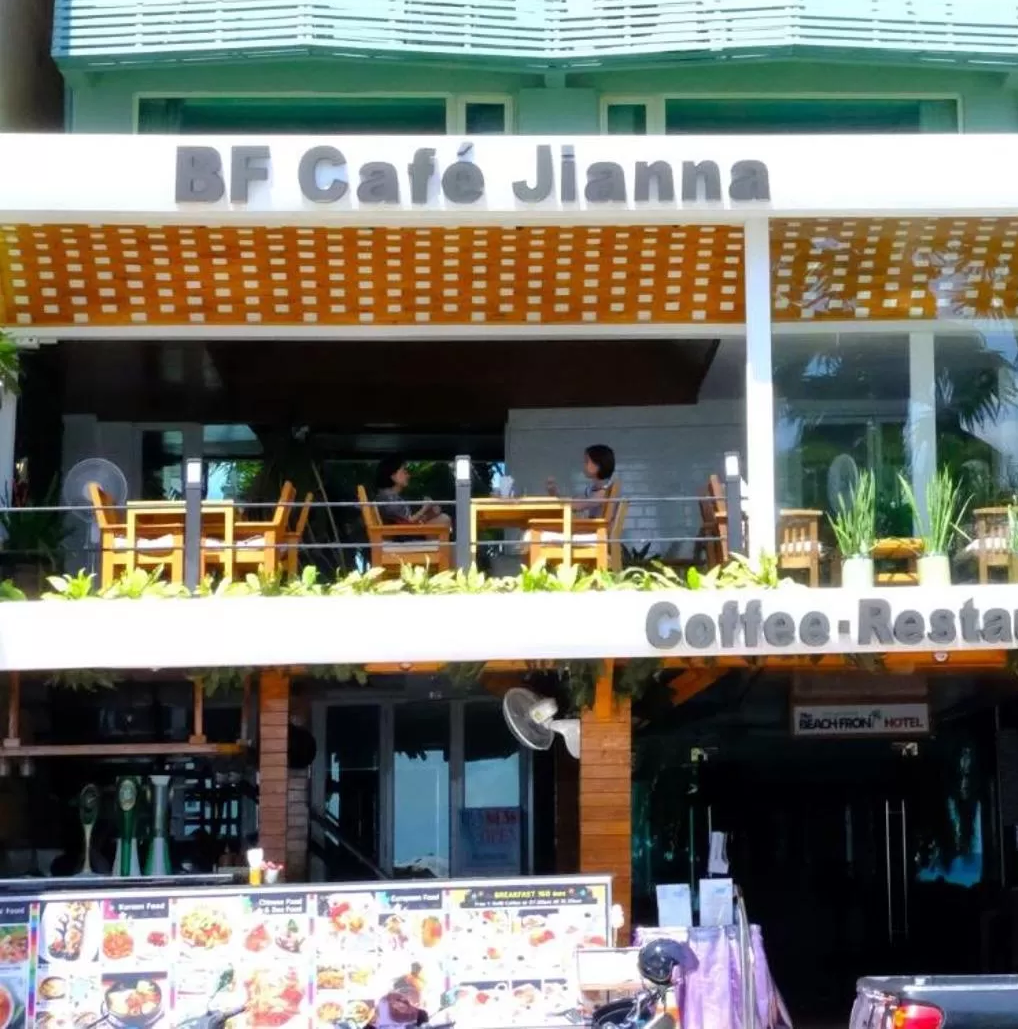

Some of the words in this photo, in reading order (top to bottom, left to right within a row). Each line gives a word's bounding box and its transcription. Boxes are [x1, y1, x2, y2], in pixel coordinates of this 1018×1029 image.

[175, 145, 271, 204] BF
[298, 141, 485, 204] Café
[512, 144, 771, 204] Jianna
[645, 599, 831, 650] Coffee
